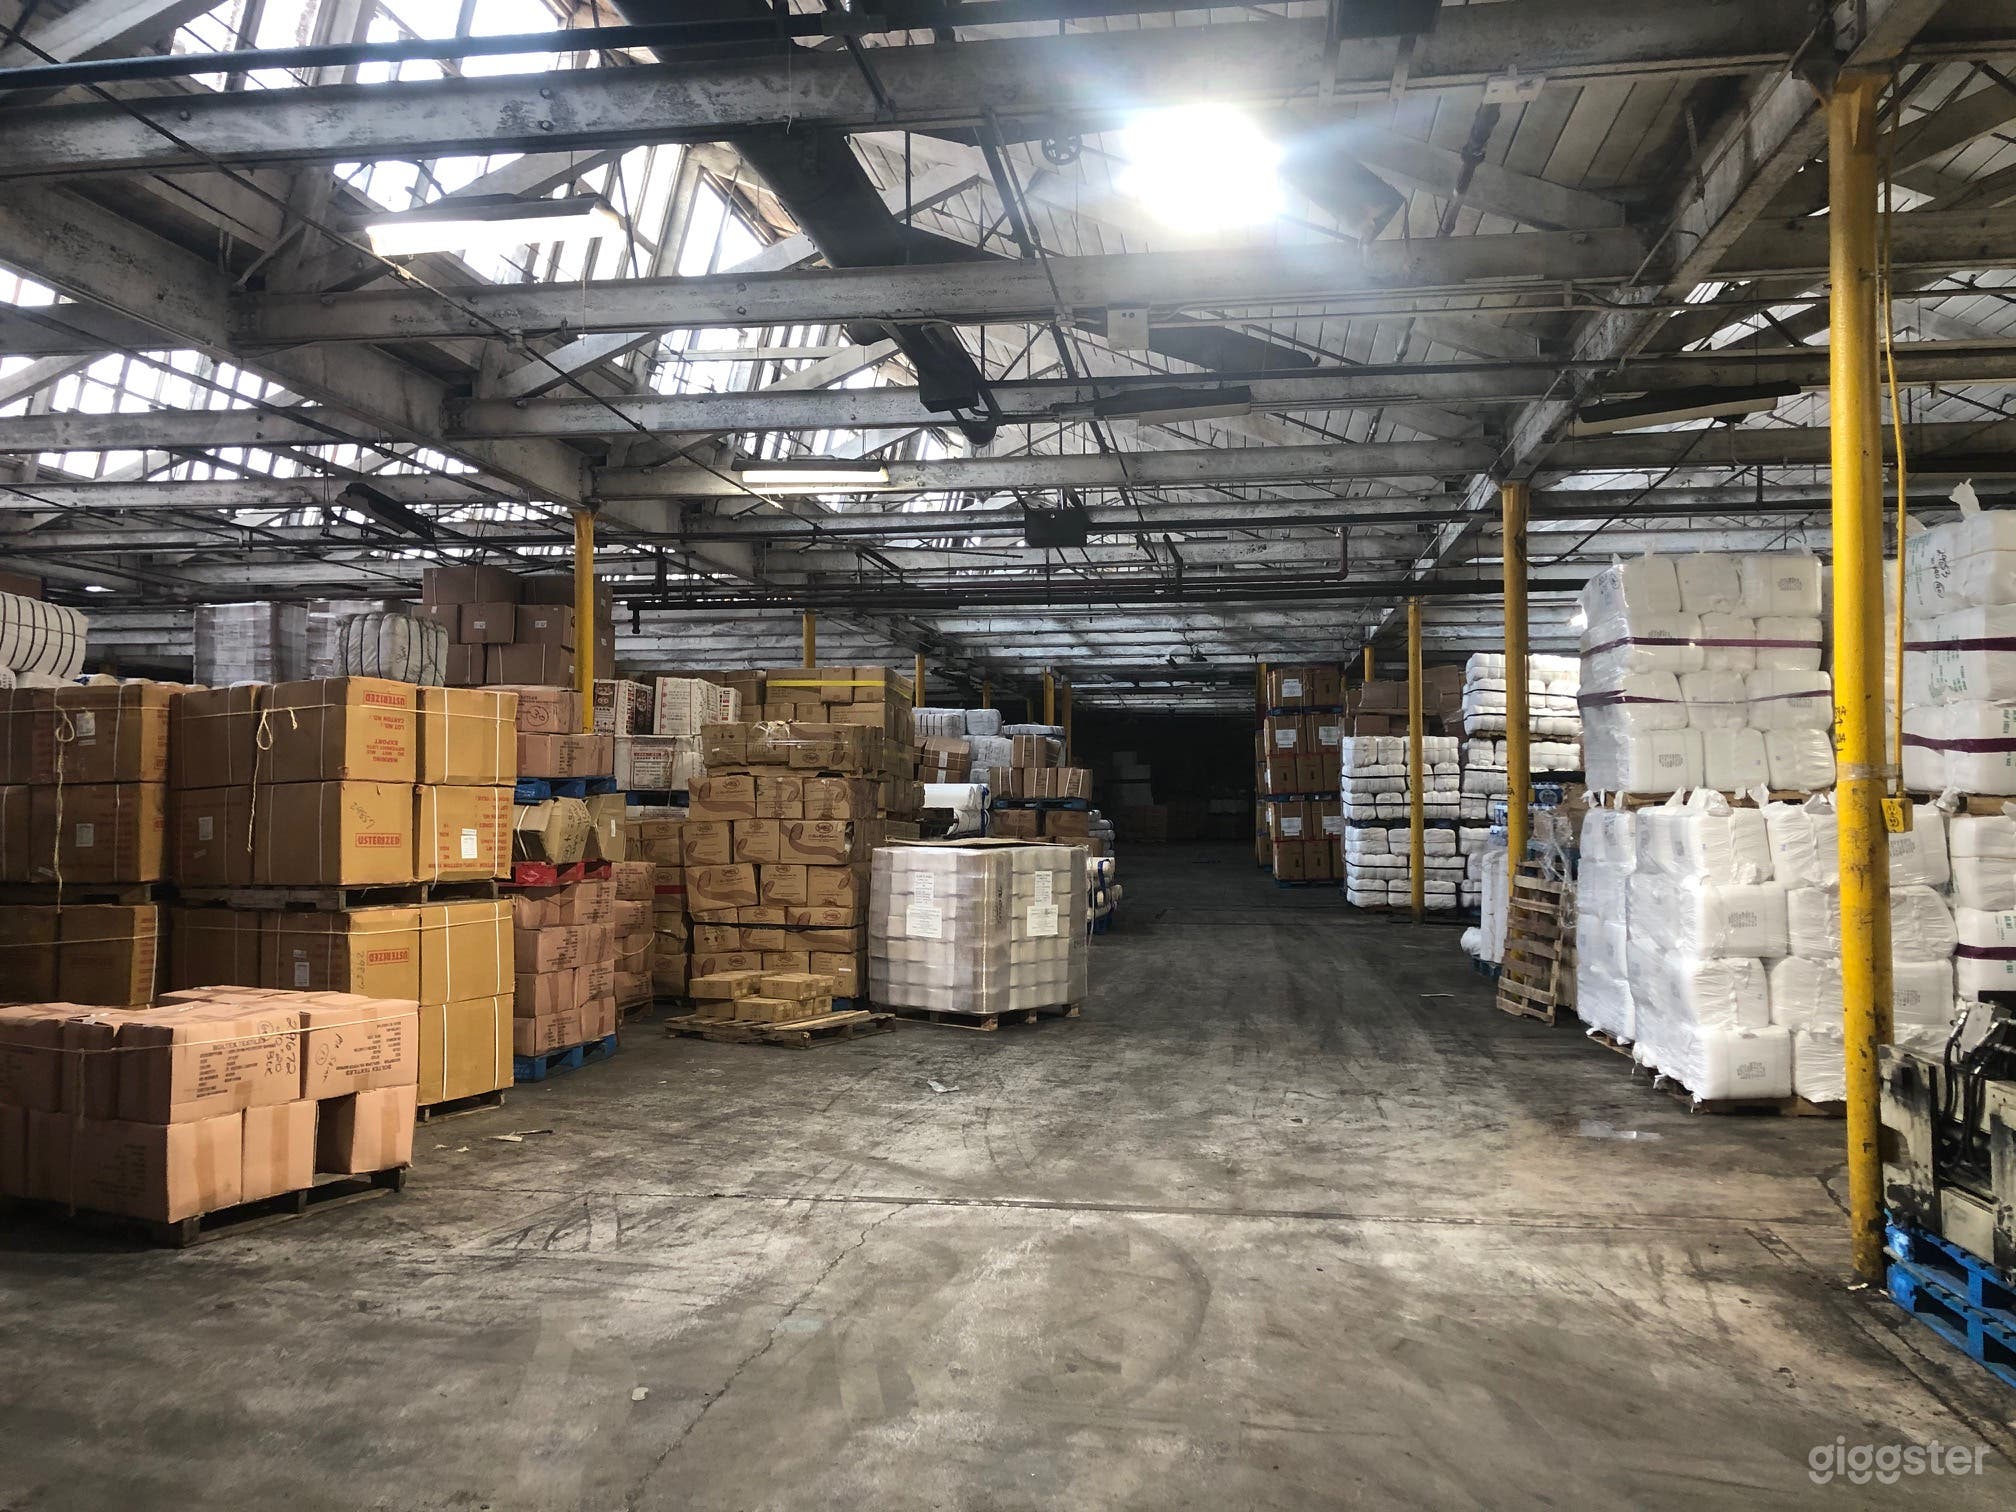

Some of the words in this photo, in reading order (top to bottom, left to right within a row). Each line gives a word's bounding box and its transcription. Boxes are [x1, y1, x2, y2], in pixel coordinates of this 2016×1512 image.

[365, 693, 406, 706] USTERIZED
[357, 836, 400, 845] USTERIZED
[368, 950, 409, 963] USTERIZED
